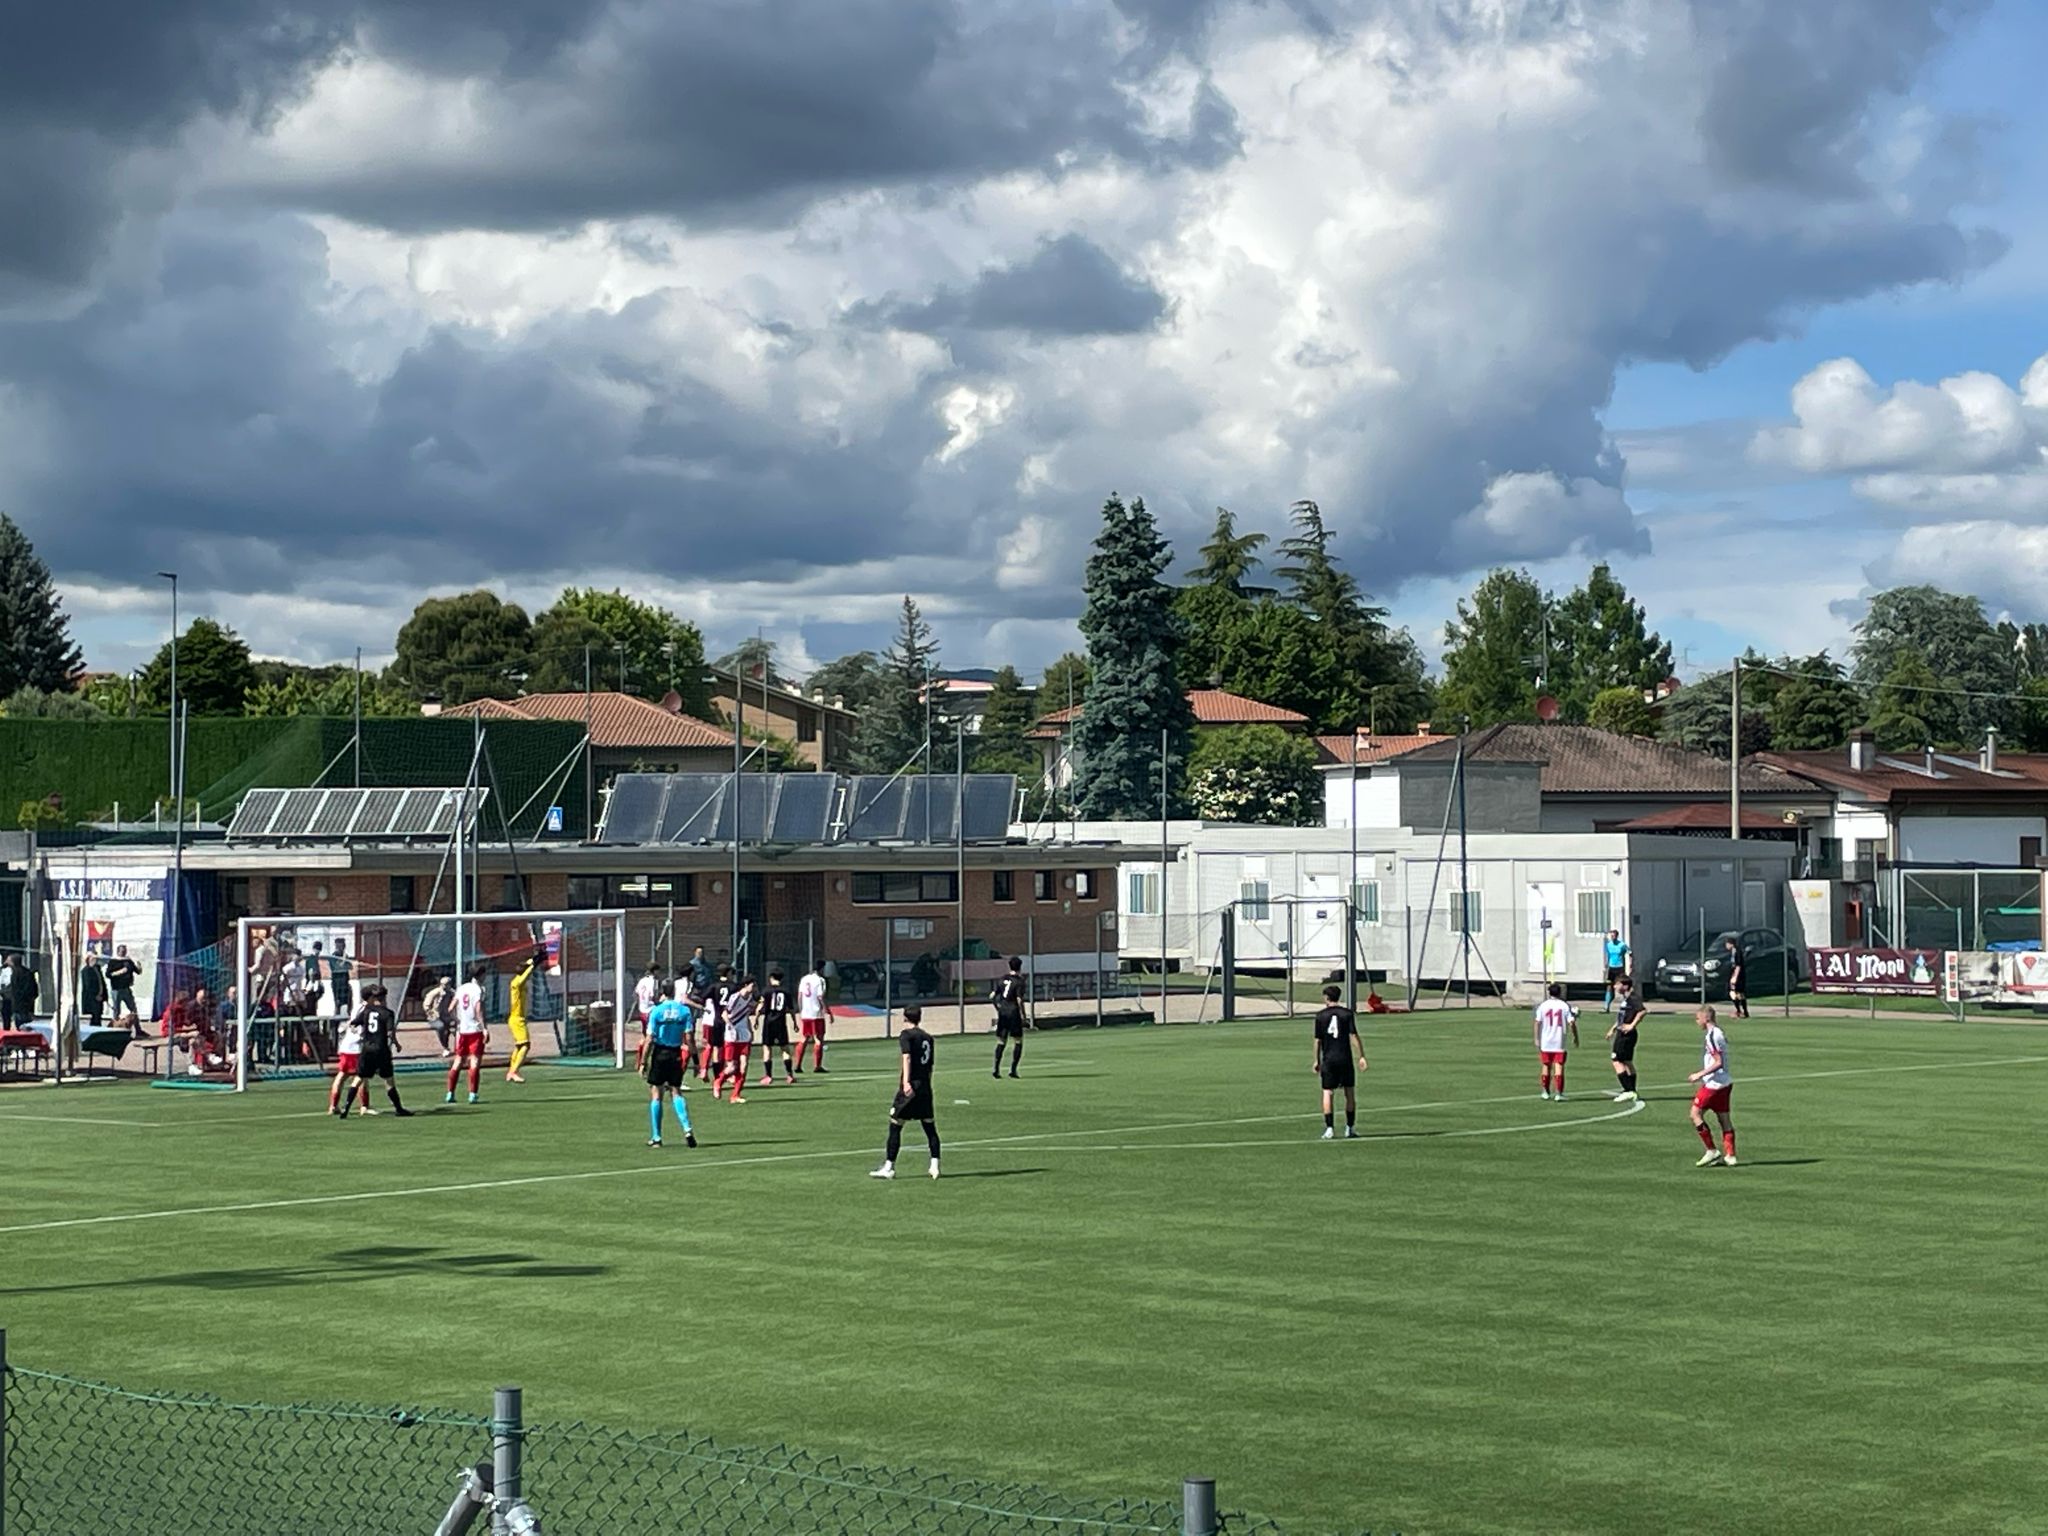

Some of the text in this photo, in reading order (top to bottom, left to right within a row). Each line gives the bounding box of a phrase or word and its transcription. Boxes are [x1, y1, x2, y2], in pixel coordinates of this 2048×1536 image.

[1826, 952, 1851, 977] Al
[719, 987, 729, 1006] 2
[804, 982, 812, 998] 3
[1002, 979, 1012, 998] 7
[462, 993, 470, 1011] 9
[368, 1011, 379, 1033] 5
[1327, 1014, 1339, 1039] 4
[1545, 1008, 1563, 1028] 11
[920, 1040, 931, 1065] 3
